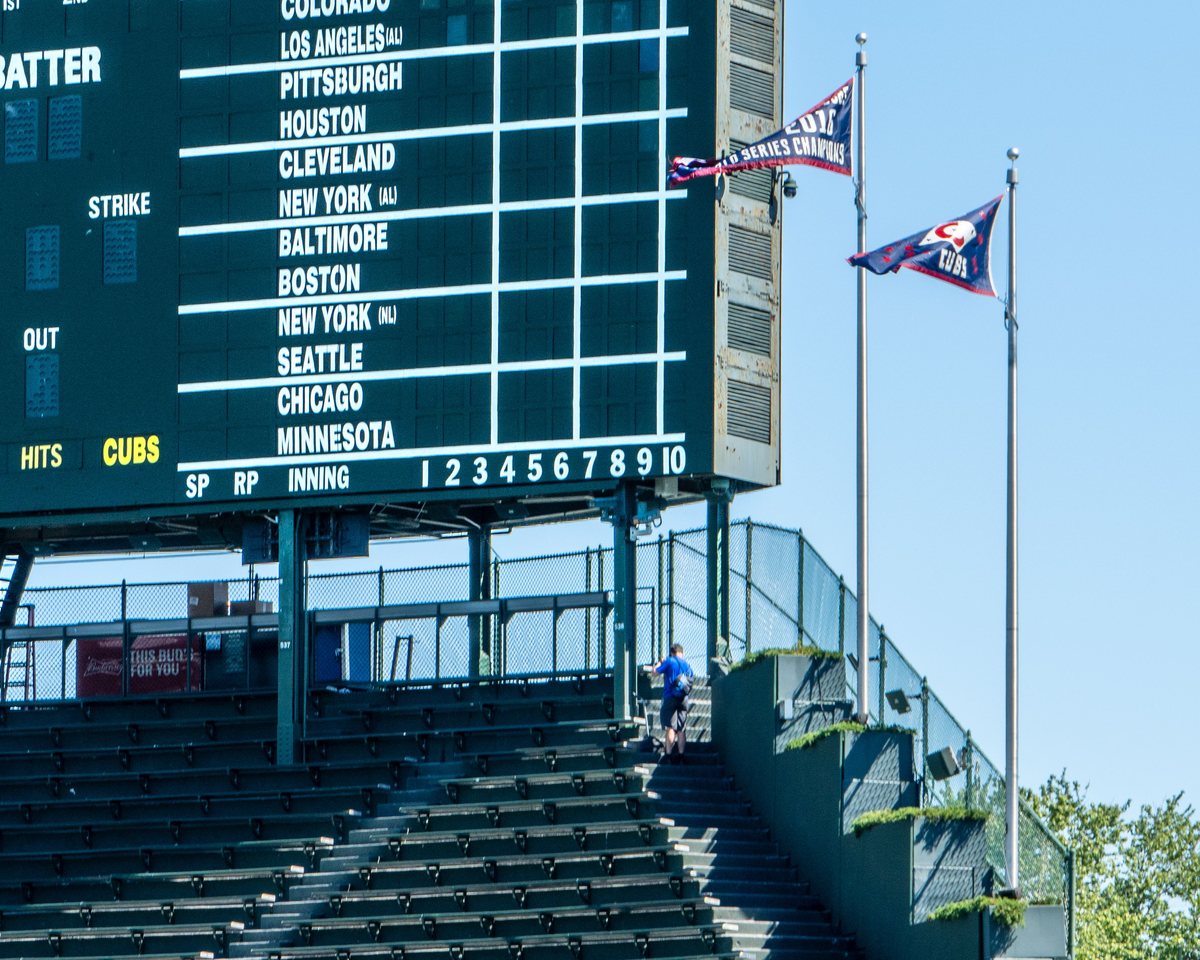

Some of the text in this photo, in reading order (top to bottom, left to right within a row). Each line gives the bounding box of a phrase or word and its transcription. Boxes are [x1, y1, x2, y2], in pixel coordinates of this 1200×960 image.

[281, 31, 310, 59] LOS
[281, 62, 402, 99] PITTSBURGH
[280, 105, 366, 138] HOUSTON
[279, 143, 395, 178] CLEVELAND
[741, 139, 791, 161] SERIES
[792, 136, 845, 166] CHAMPIONS
[89, 192, 150, 218] STRIKE
[280, 184, 397, 217] NEW YORK (AL)
[280, 223, 387, 256] BALTIMORE
[939, 248, 968, 279] CUBS
[279, 264, 360, 296] BOSTON
[279, 303, 396, 336] NEW YORK (NL)
[24, 327, 59, 350] OUT
[278, 343, 363, 375] SEATTLE
[278, 383, 363, 415] CHICAGO
[103, 435, 159, 465] CUBS
[278, 421, 395, 455] MINNESOTA
[21, 444, 63, 469] HITS
[186, 446, 685, 498] SP RP INNING 1 2 3 4 5 6 7 8 9 10
[130, 650, 156, 664] THIS
[131, 662, 179, 678] FOR YOU
